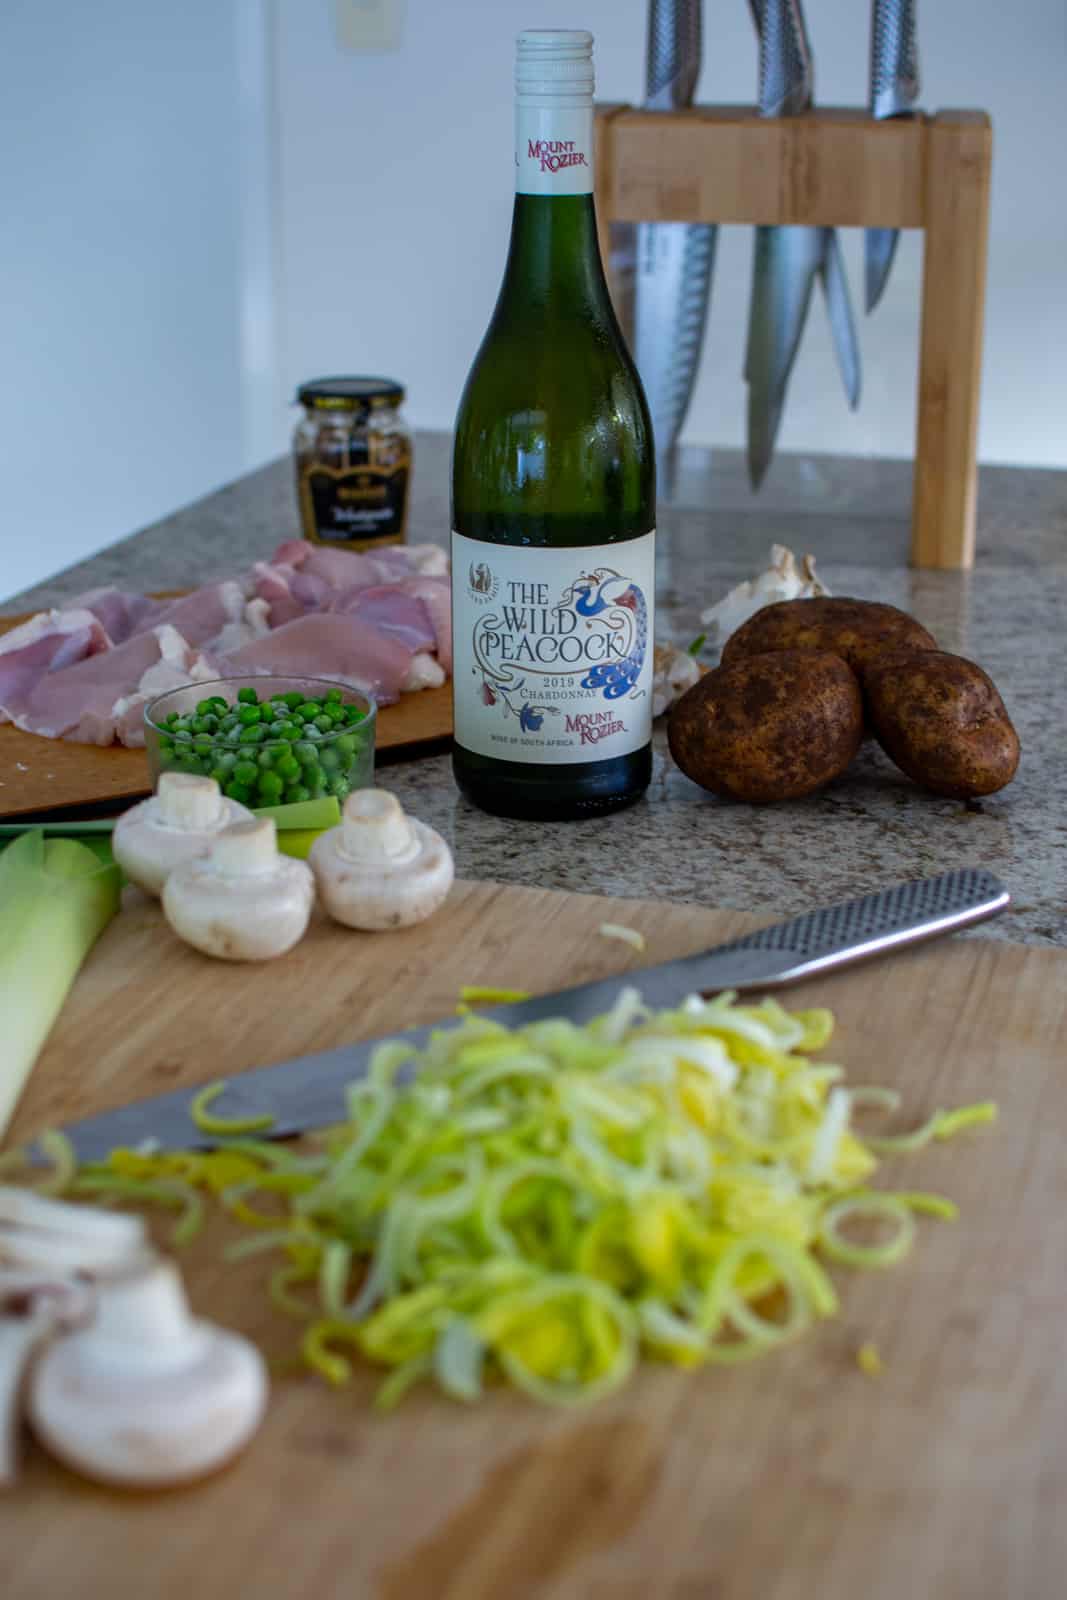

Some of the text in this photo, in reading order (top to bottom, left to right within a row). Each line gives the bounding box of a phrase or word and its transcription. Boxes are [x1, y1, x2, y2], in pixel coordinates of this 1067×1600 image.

[528, 138, 576, 158] MOUNT
[541, 152, 588, 173] ROZIER
[507, 582, 549, 605] THE
[502, 606, 577, 634] WILD
[485, 631, 627, 662] PEACOCK
[543, 677, 574, 688] 2019
[520, 688, 596, 700] CHARDONNAY
[565, 711, 613, 733] MOUNT
[581, 721, 628, 745] ROZIER
